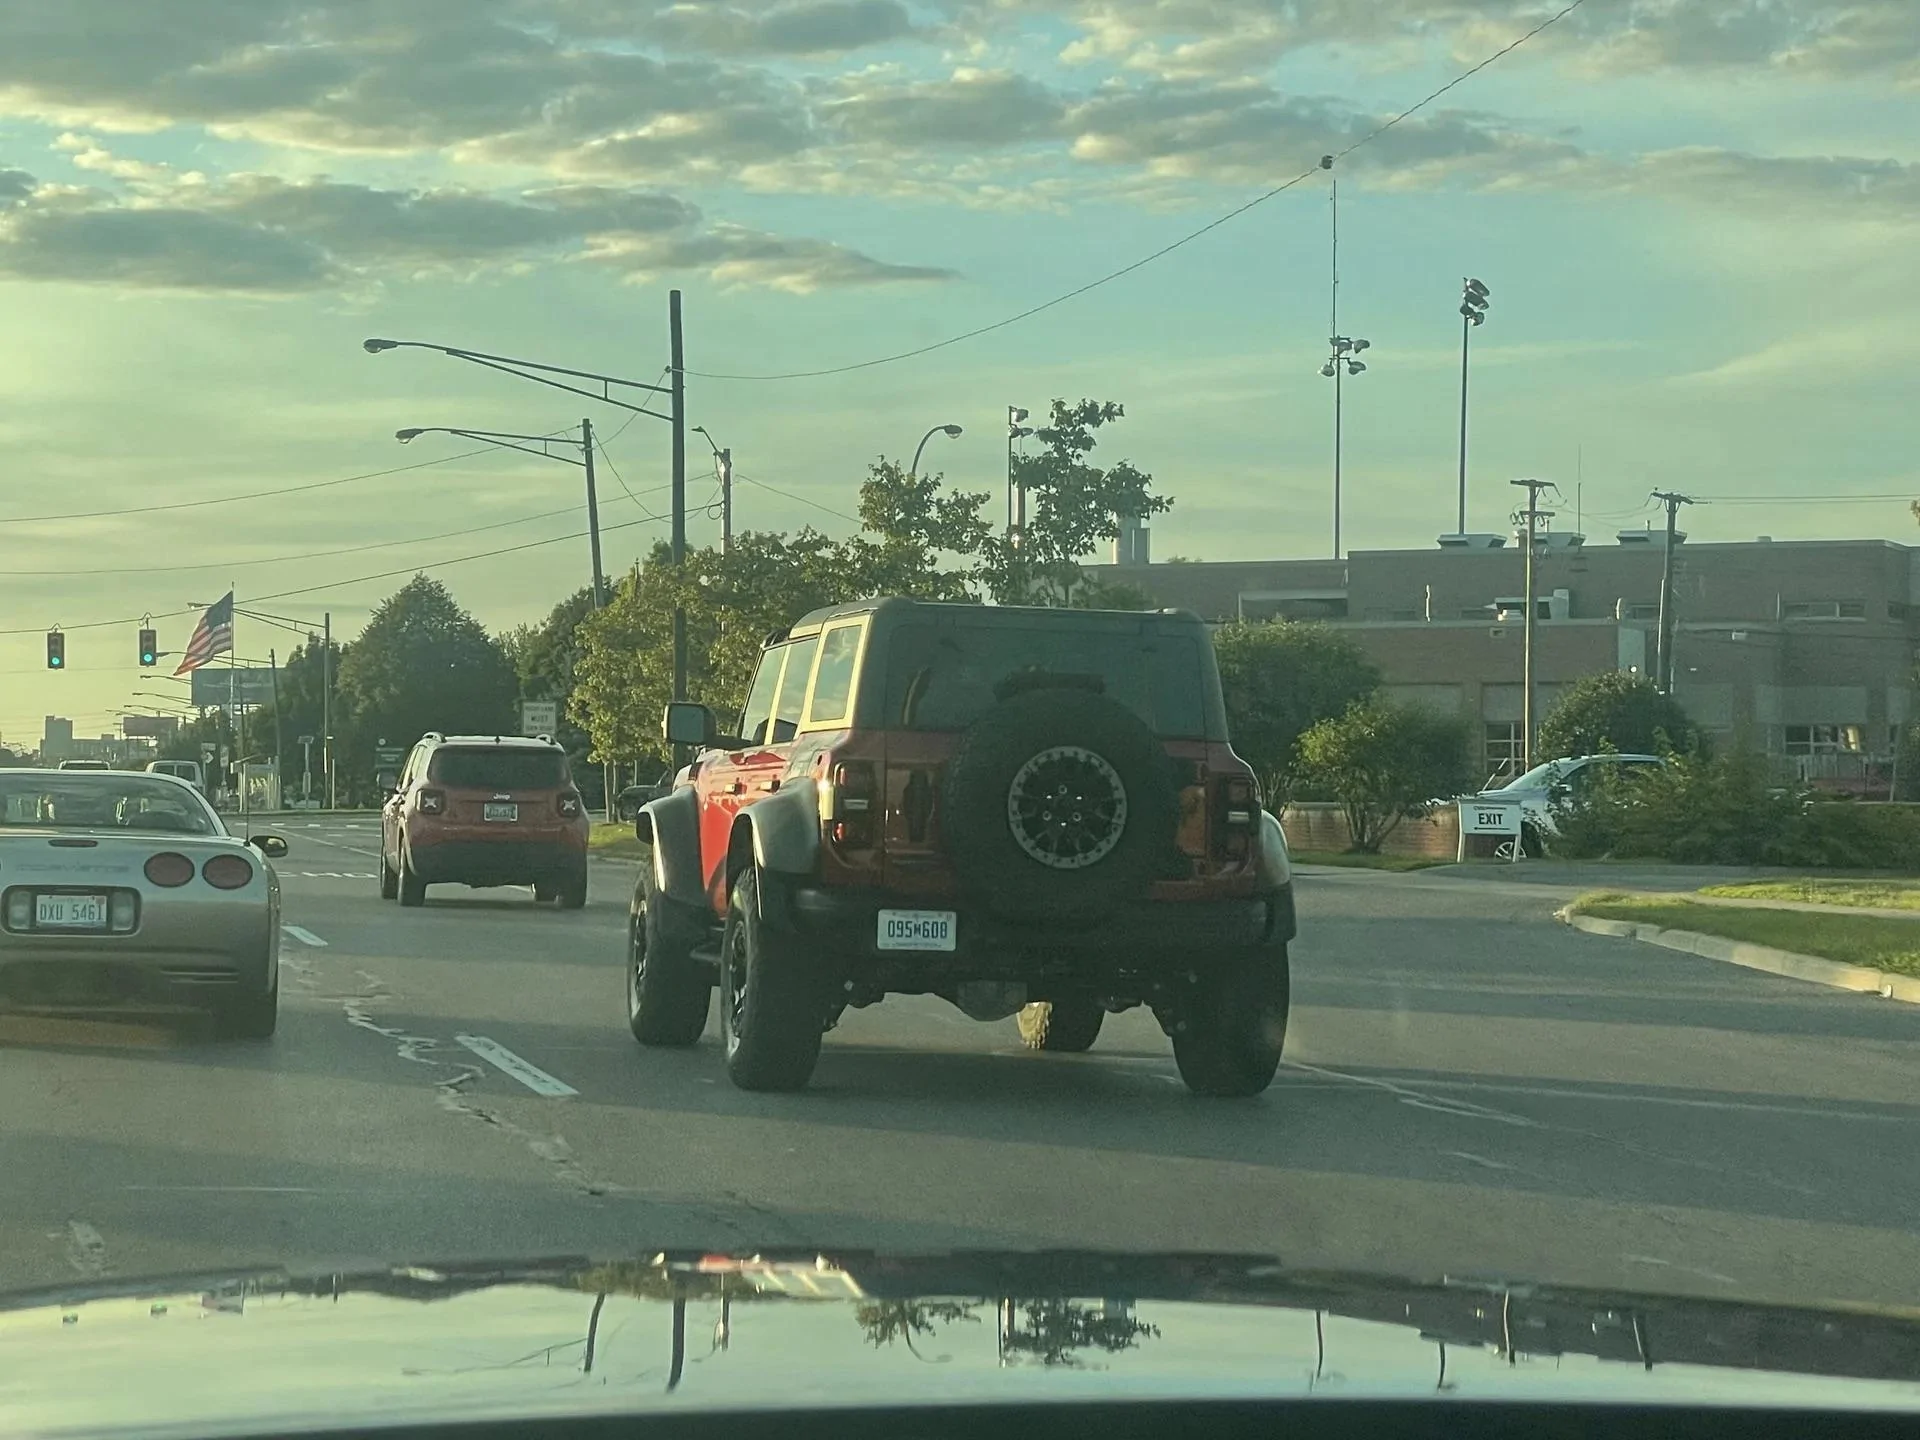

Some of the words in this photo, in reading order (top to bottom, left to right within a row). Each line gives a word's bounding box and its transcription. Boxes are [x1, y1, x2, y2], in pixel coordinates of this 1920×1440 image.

[1478, 813, 1503, 825] EXIT
[40, 903, 63, 921] DXU
[72, 904, 104, 921] 5461
